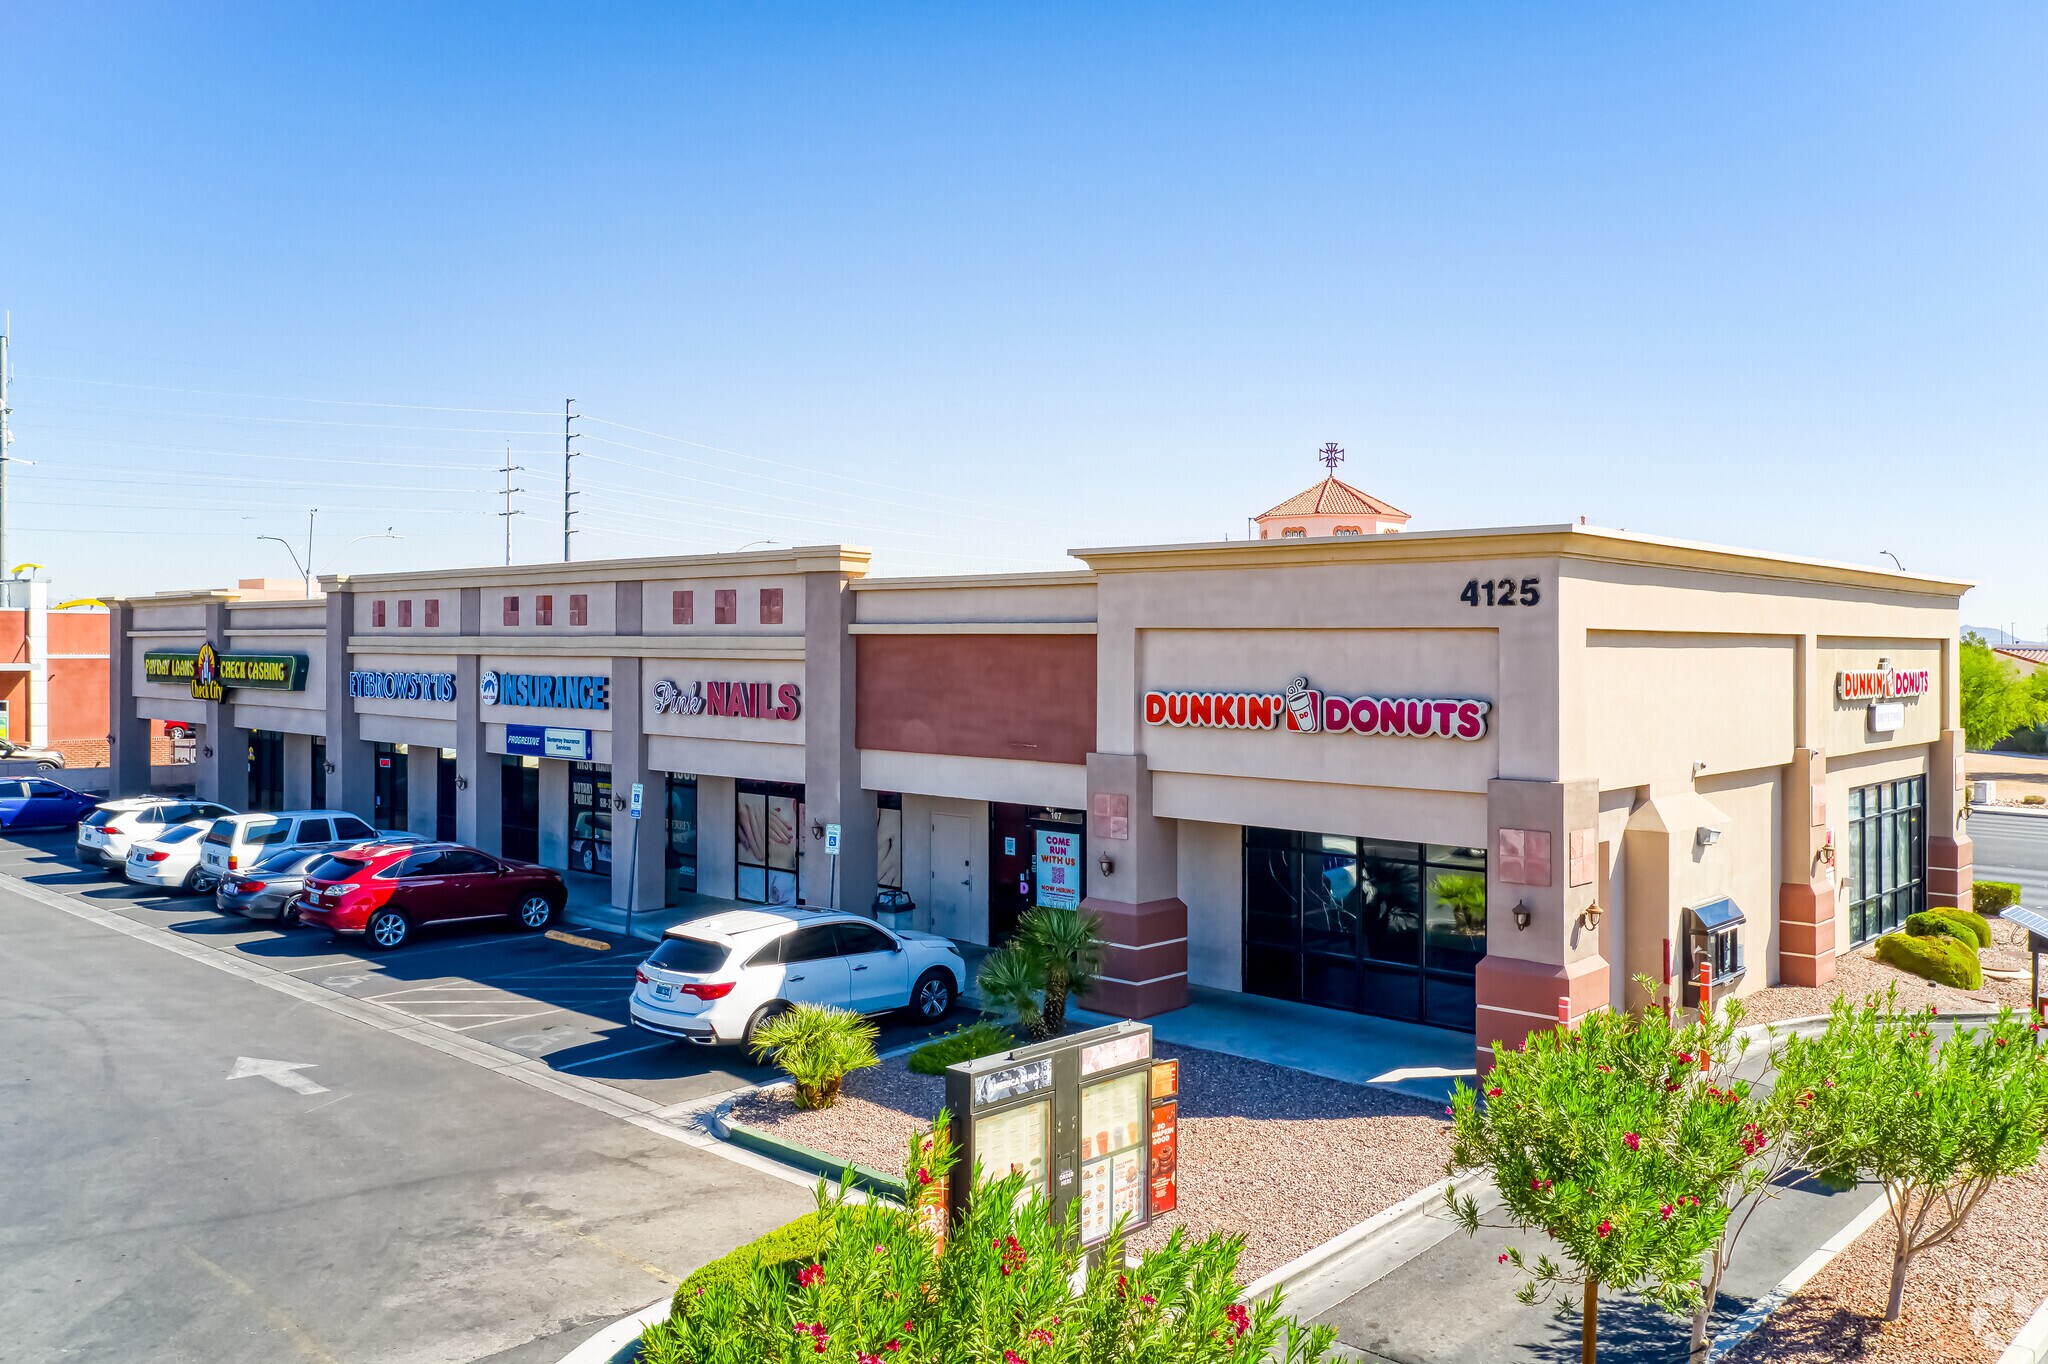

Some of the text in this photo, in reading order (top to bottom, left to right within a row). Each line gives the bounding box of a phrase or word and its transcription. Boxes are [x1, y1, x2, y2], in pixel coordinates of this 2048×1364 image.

[1461, 577, 1540, 607] 4125
[145, 659, 285, 681] PAYDAY LOANS CHECK CASHING
[349, 671, 418, 700] EYEBROWS
[1895, 670, 1928, 695] DONUTS
[190, 679, 223, 703] Check City
[500, 673, 609, 710] INSURANCE
[653, 680, 801, 721] Pink NAILS
[1145, 694, 1480, 738] DUNKIN' DONUTS
[508, 735, 540, 746] PROGRESSIVE
[573, 782, 593, 794] NOTARY
[574, 793, 593, 806] PUBLIC
[1046, 836, 1071, 847] COME
[1050, 846, 1066, 856] RUN
[1042, 855, 1075, 867] WITH US
[1041, 884, 1075, 895] NOW HIRING
[1157, 1122, 1166, 1131] SO
[1152, 1127, 1174, 1139] UMPKIN
[1152, 1135, 1171, 1146] GOOD
